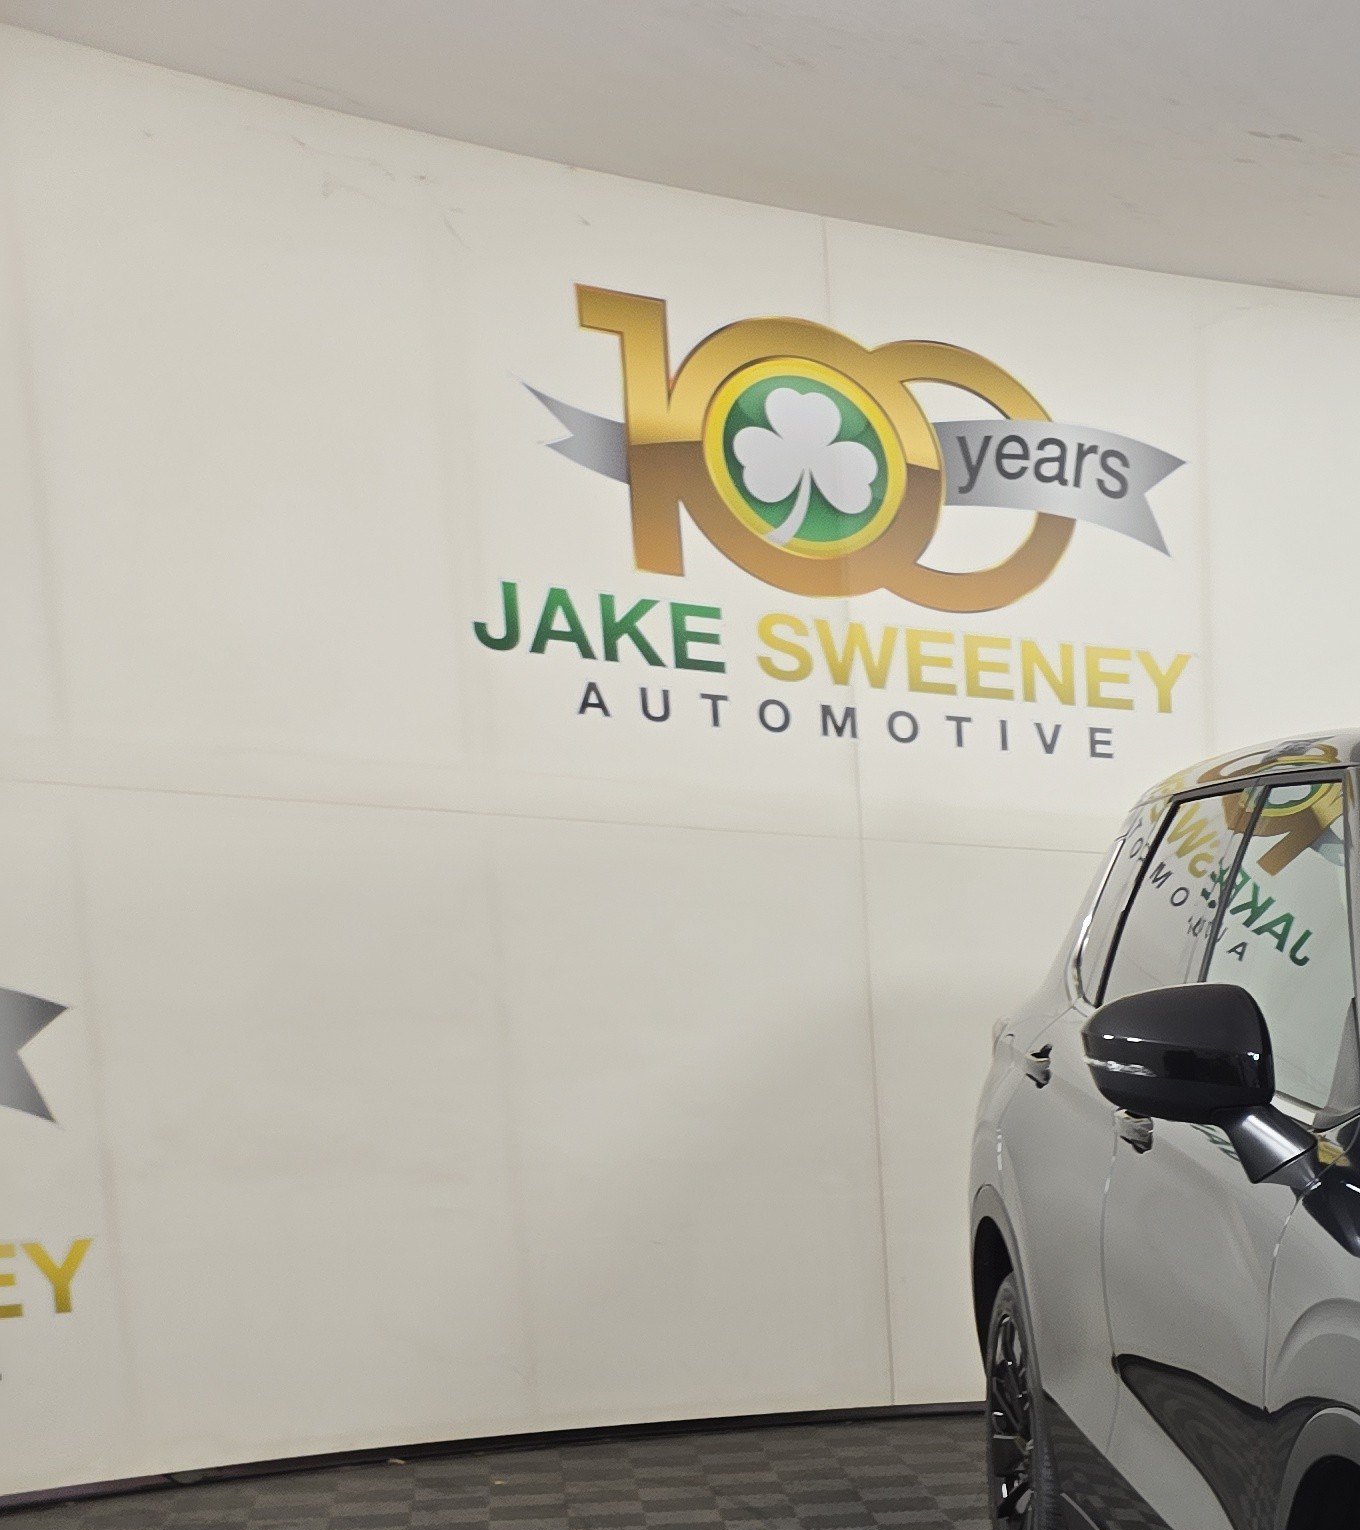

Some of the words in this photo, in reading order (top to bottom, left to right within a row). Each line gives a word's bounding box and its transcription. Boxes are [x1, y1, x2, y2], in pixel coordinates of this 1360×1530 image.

[574, 283, 1076, 613] 100
[956, 431, 1132, 499] years
[473, 581, 727, 673] JAKE
[757, 613, 1191, 714] SWEENEY
[577, 681, 1115, 759] AUTOMOTIVE
